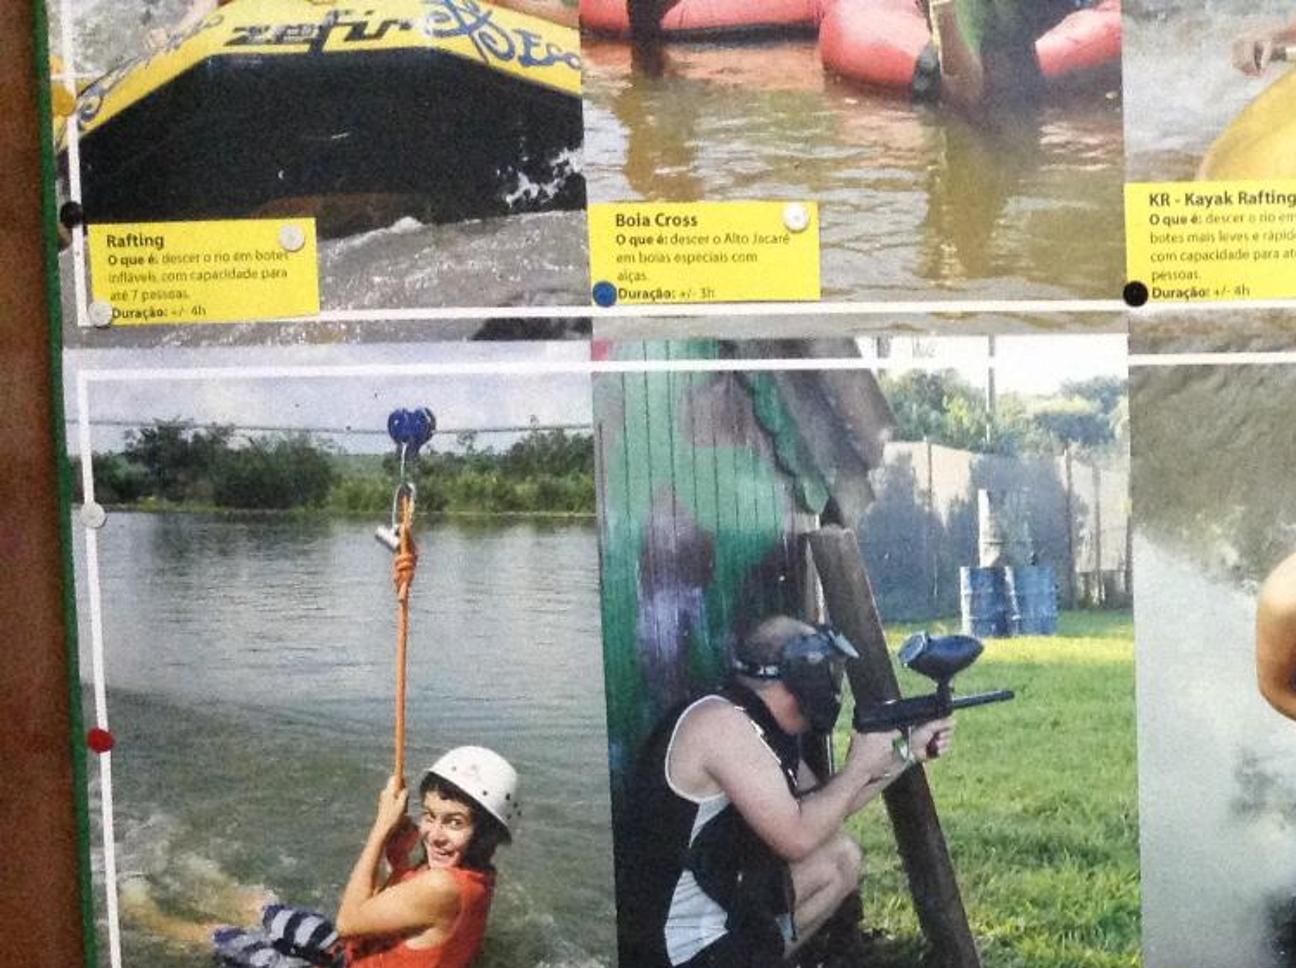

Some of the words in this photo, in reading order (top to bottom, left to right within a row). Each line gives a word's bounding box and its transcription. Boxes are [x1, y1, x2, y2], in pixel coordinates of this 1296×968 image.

[1149, 193, 1170, 207] KR
[1185, 191, 1234, 208] Kayak
[1238, 191, 1296, 207] Rafting
[615, 213, 651, 227] Boia
[655, 213, 698, 227] Cross
[1149, 215, 1159, 225] O
[1163, 216, 1188, 227] que
[106, 234, 165, 250] Rafting
[616, 234, 626, 245] O
[629, 236, 653, 247] que
[670, 234, 710, 245] descer
[724, 233, 749, 244] Alto
[108, 255, 118, 266] O
[120, 256, 145, 267] que
[616, 254, 635, 263] em
[674, 251, 728, 264] especiais
[731, 252, 757, 262] com
[1180, 249, 1250, 262] capacidade
[1253, 250, 1280, 261] para
[162, 273, 187, 282] com
[261, 271, 287, 280] para
[618, 287, 675, 301] Duração:
[1152, 287, 1210, 301] Duração:
[112, 307, 168, 320] Duração:
